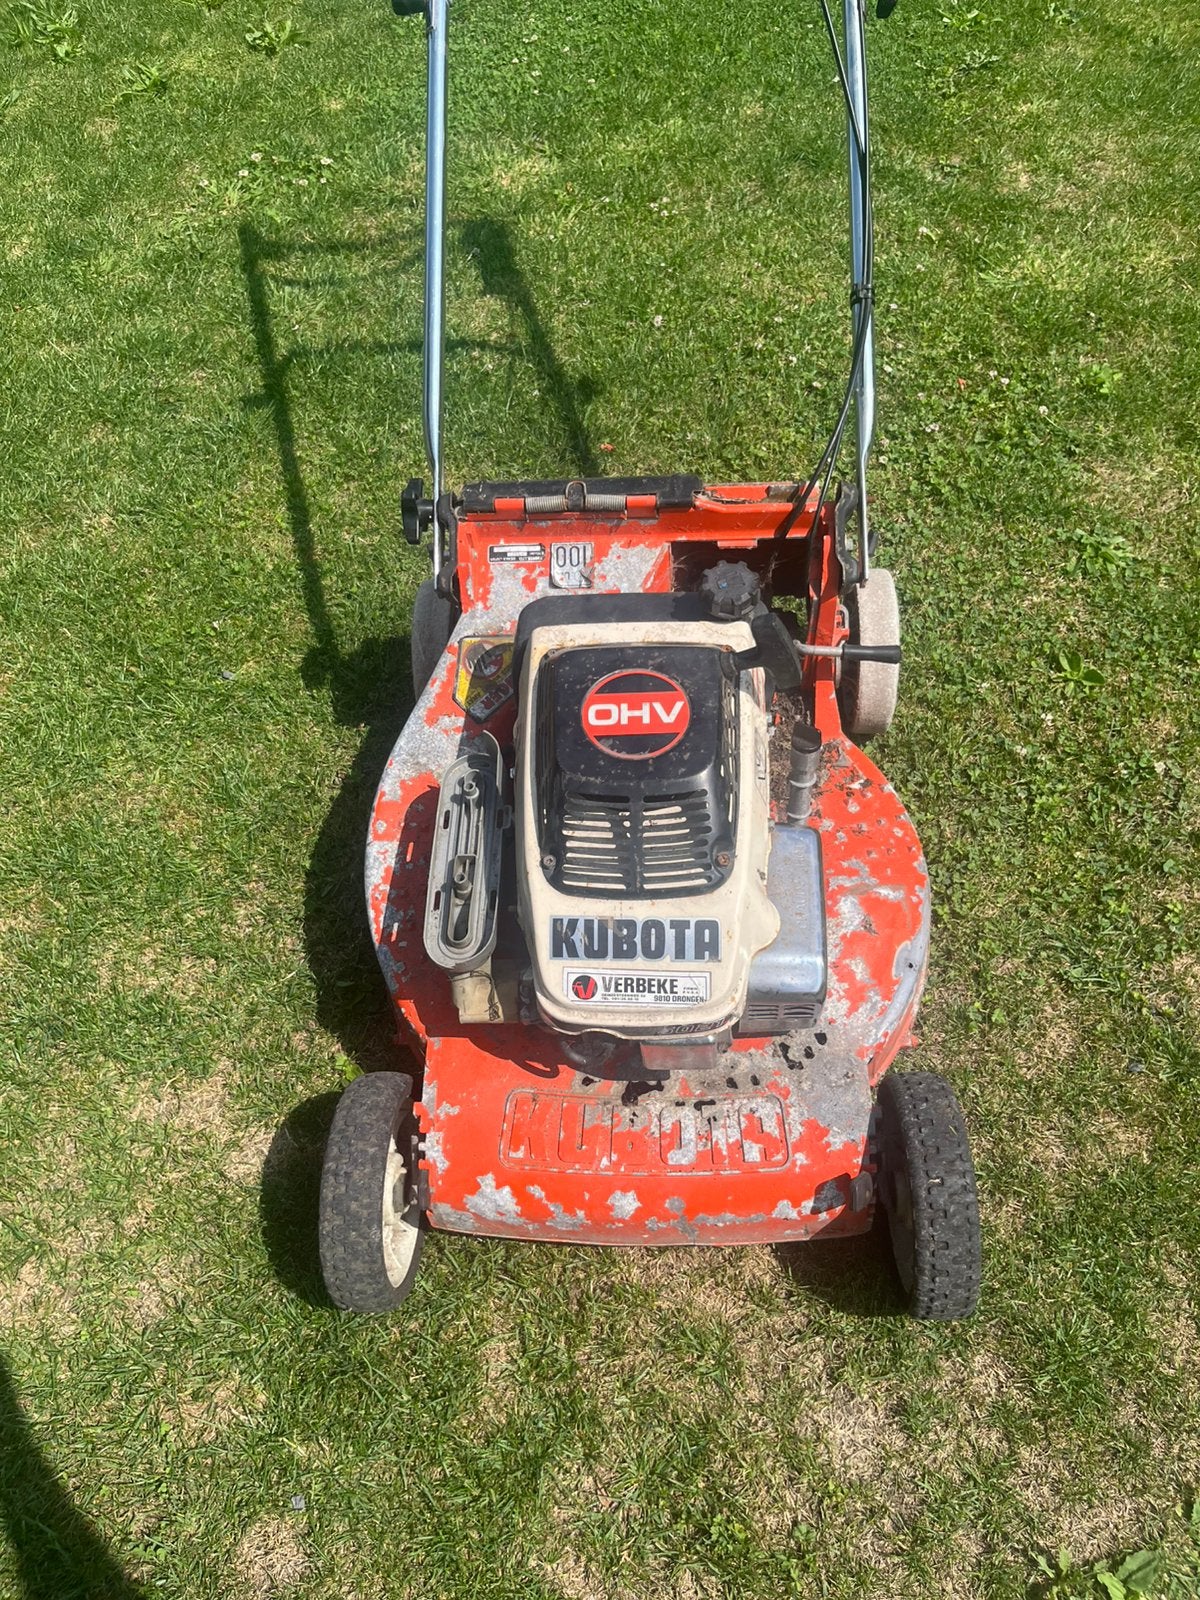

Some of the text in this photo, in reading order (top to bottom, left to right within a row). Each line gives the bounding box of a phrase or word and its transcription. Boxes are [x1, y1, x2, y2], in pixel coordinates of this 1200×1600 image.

[587, 701, 685, 726] OHV
[551, 917, 720, 961] KUBOTA
[601, 976, 679, 994] VERBEKE
